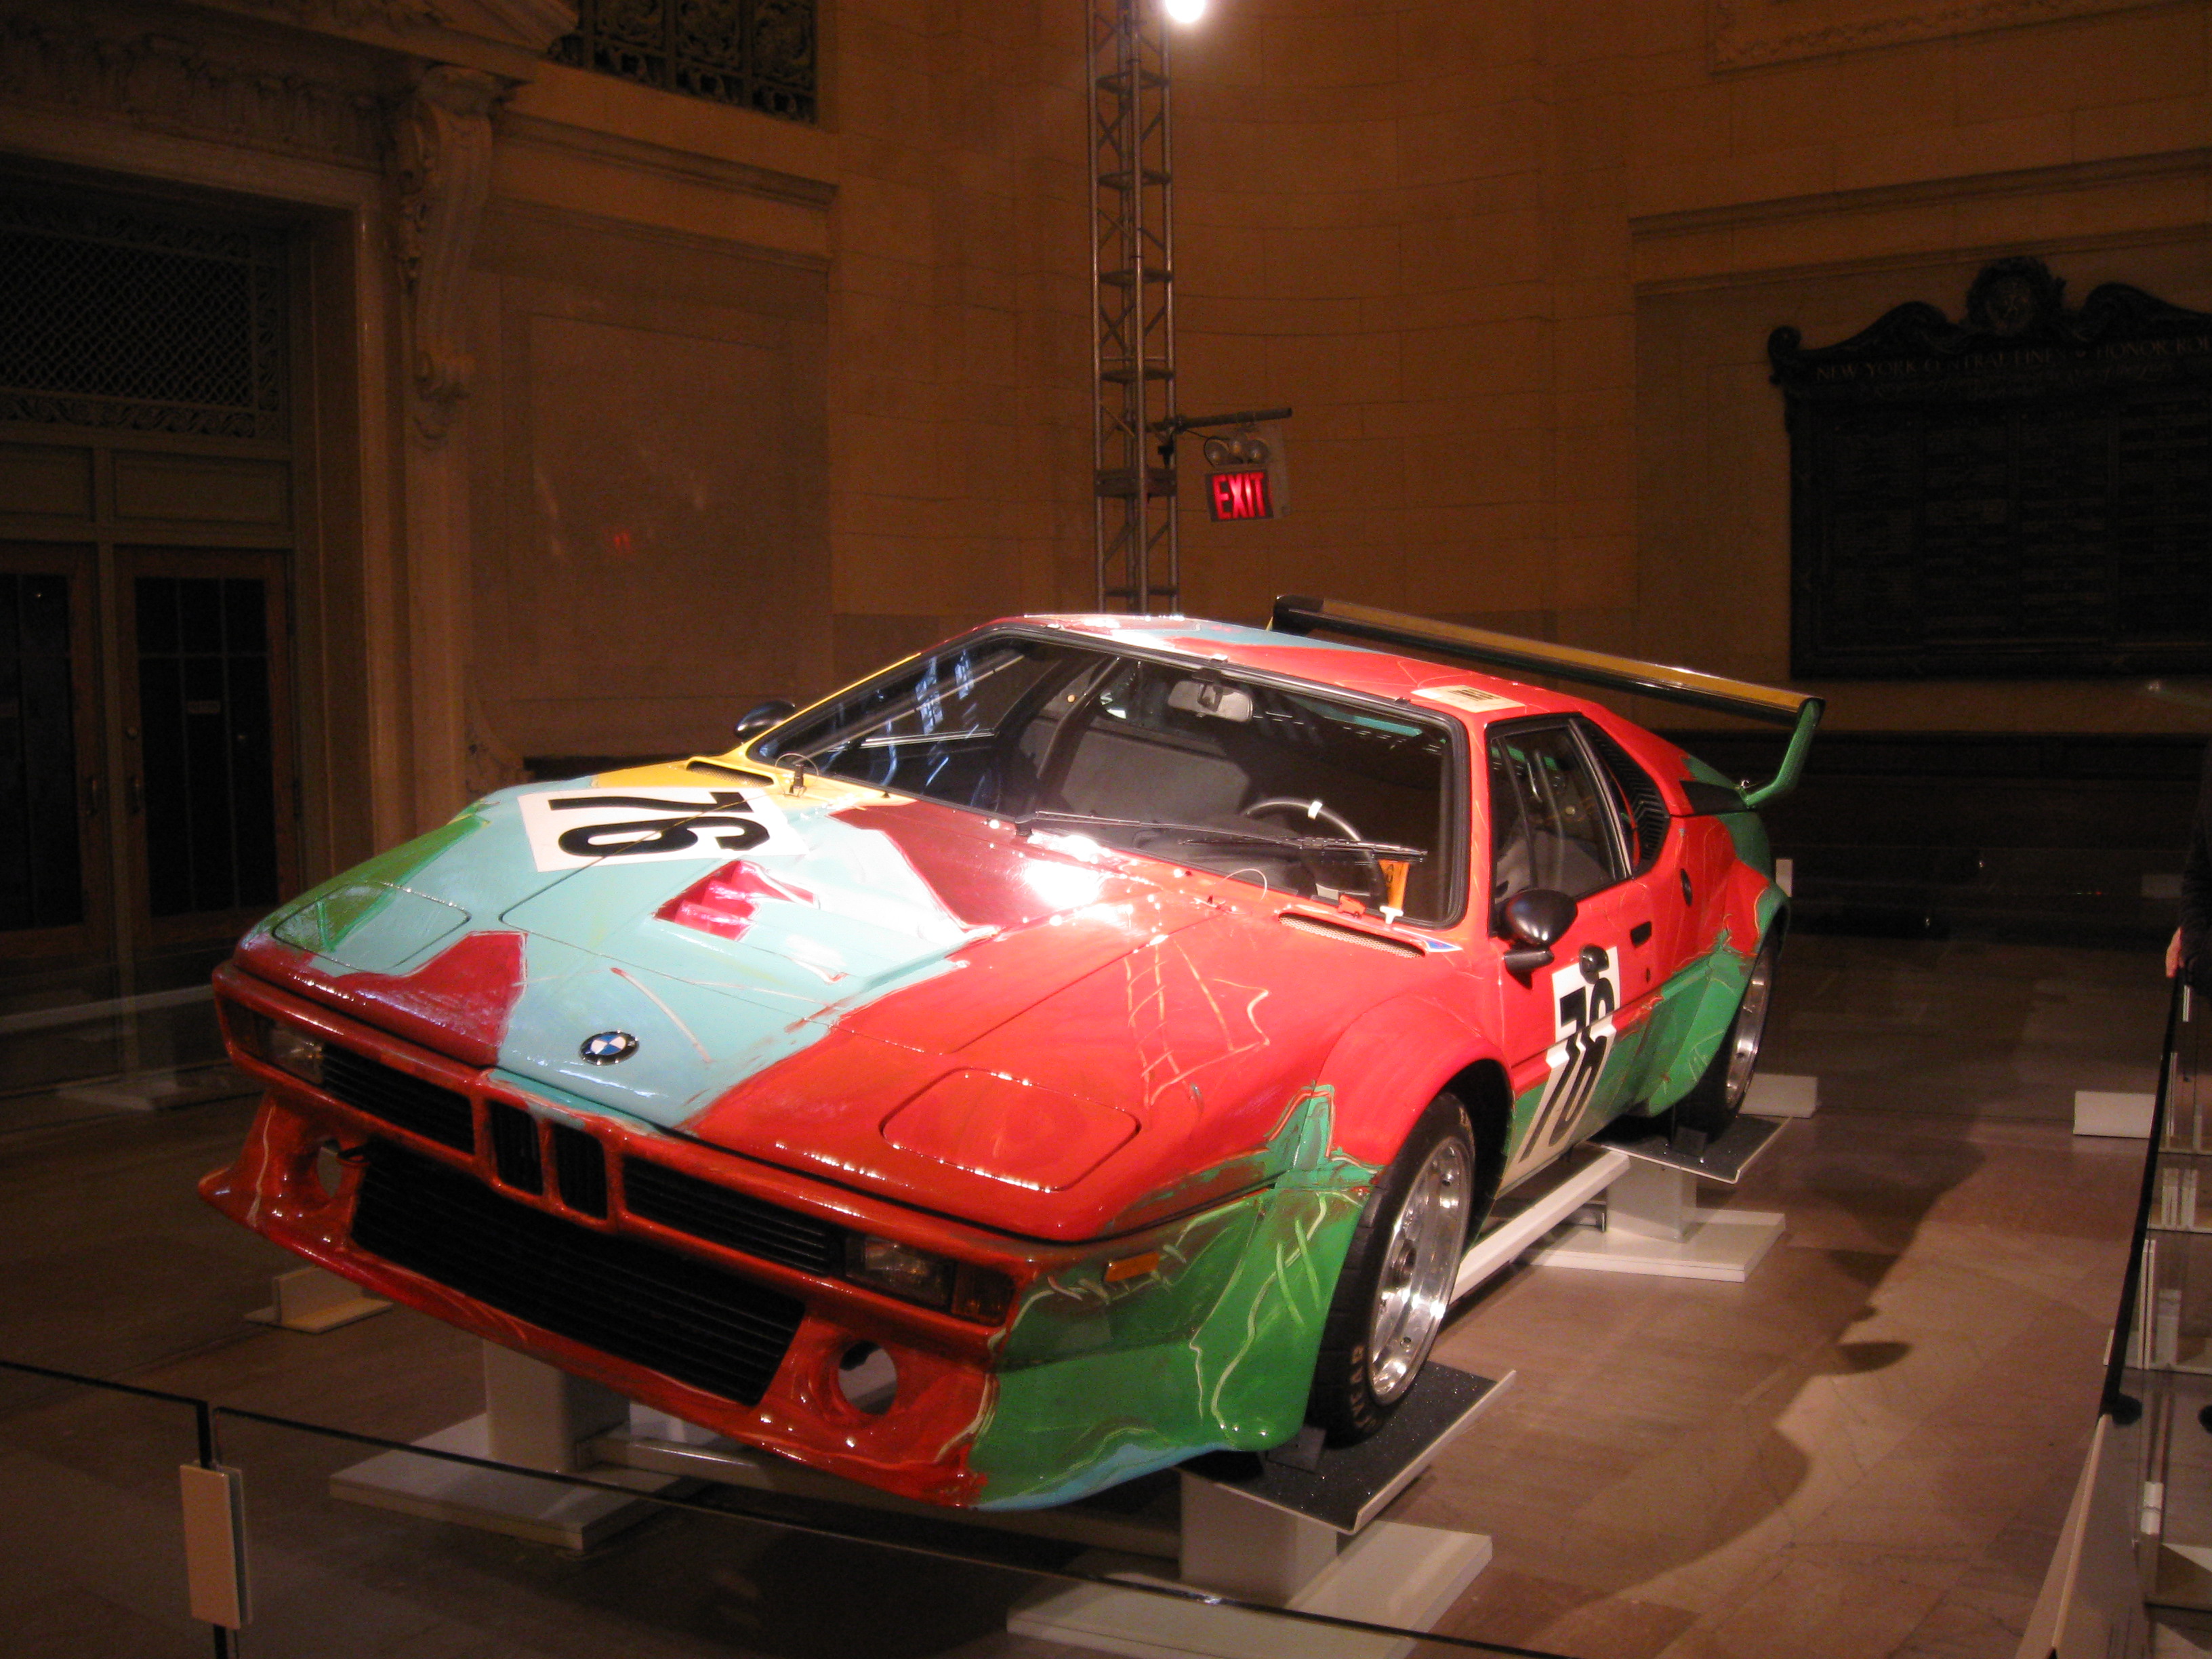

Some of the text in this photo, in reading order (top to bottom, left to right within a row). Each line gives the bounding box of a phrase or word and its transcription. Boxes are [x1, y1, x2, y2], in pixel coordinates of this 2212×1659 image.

[1817, 363, 1858, 381] NEW
[1866, 359, 1917, 377] YORK
[1212, 472, 1265, 520] EXIT
